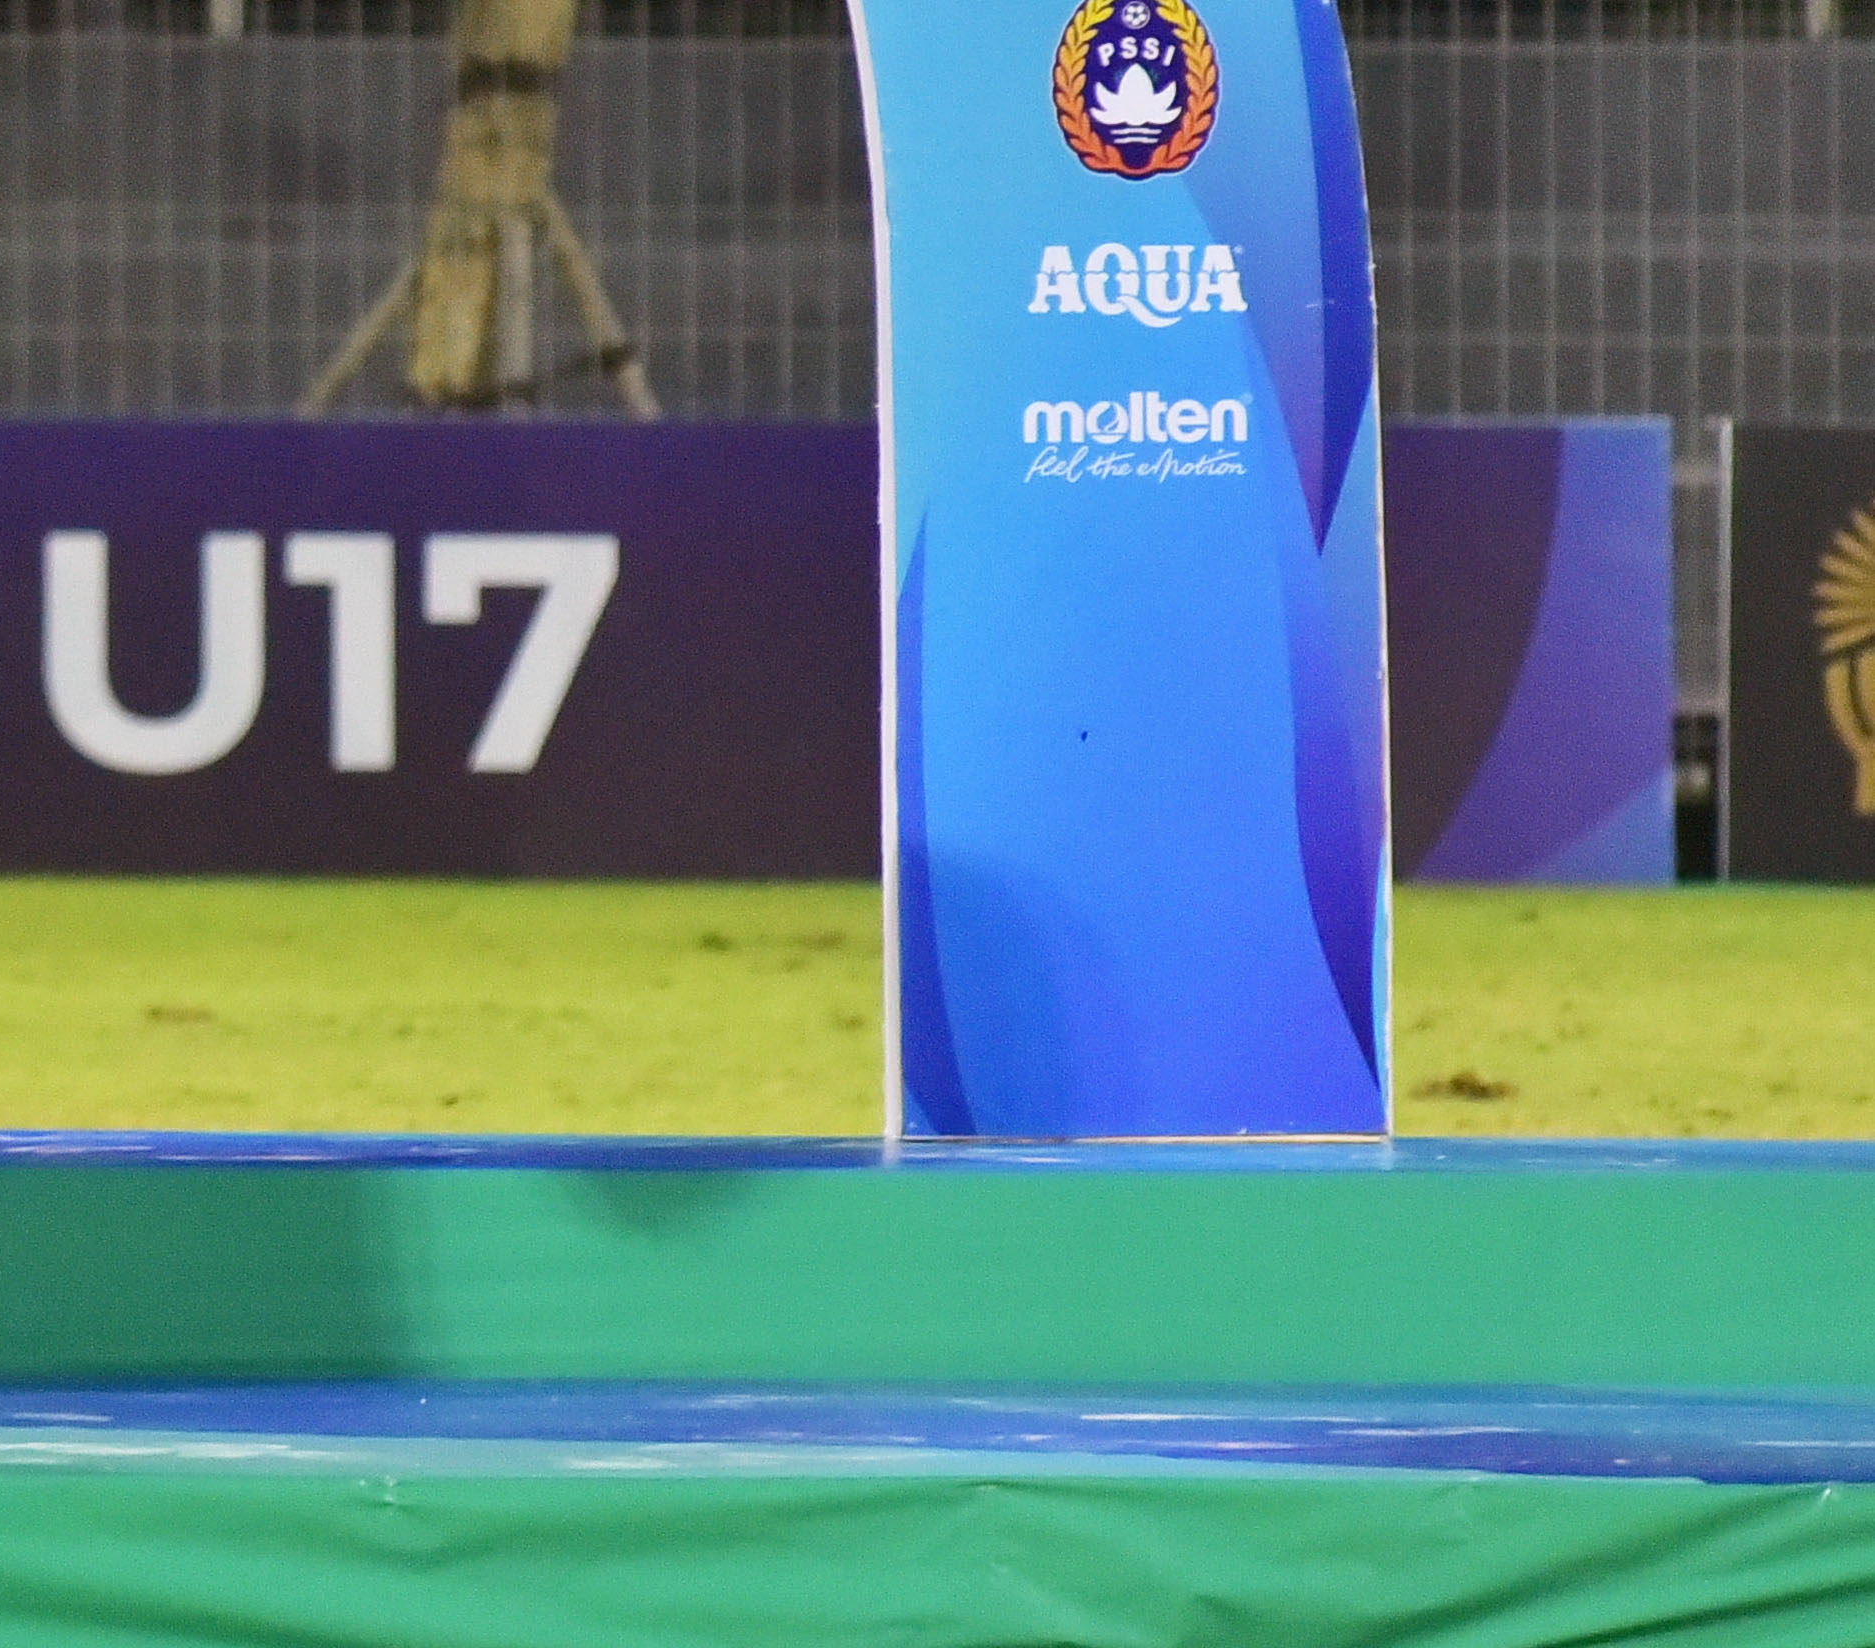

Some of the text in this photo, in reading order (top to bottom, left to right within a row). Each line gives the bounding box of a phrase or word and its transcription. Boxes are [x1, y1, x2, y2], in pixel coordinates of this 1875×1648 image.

[1097, 36, 1176, 67] PSSI
[1028, 242, 1247, 328] AQUA
[1024, 391, 1248, 444] molten
[43, 531, 620, 777] U17
